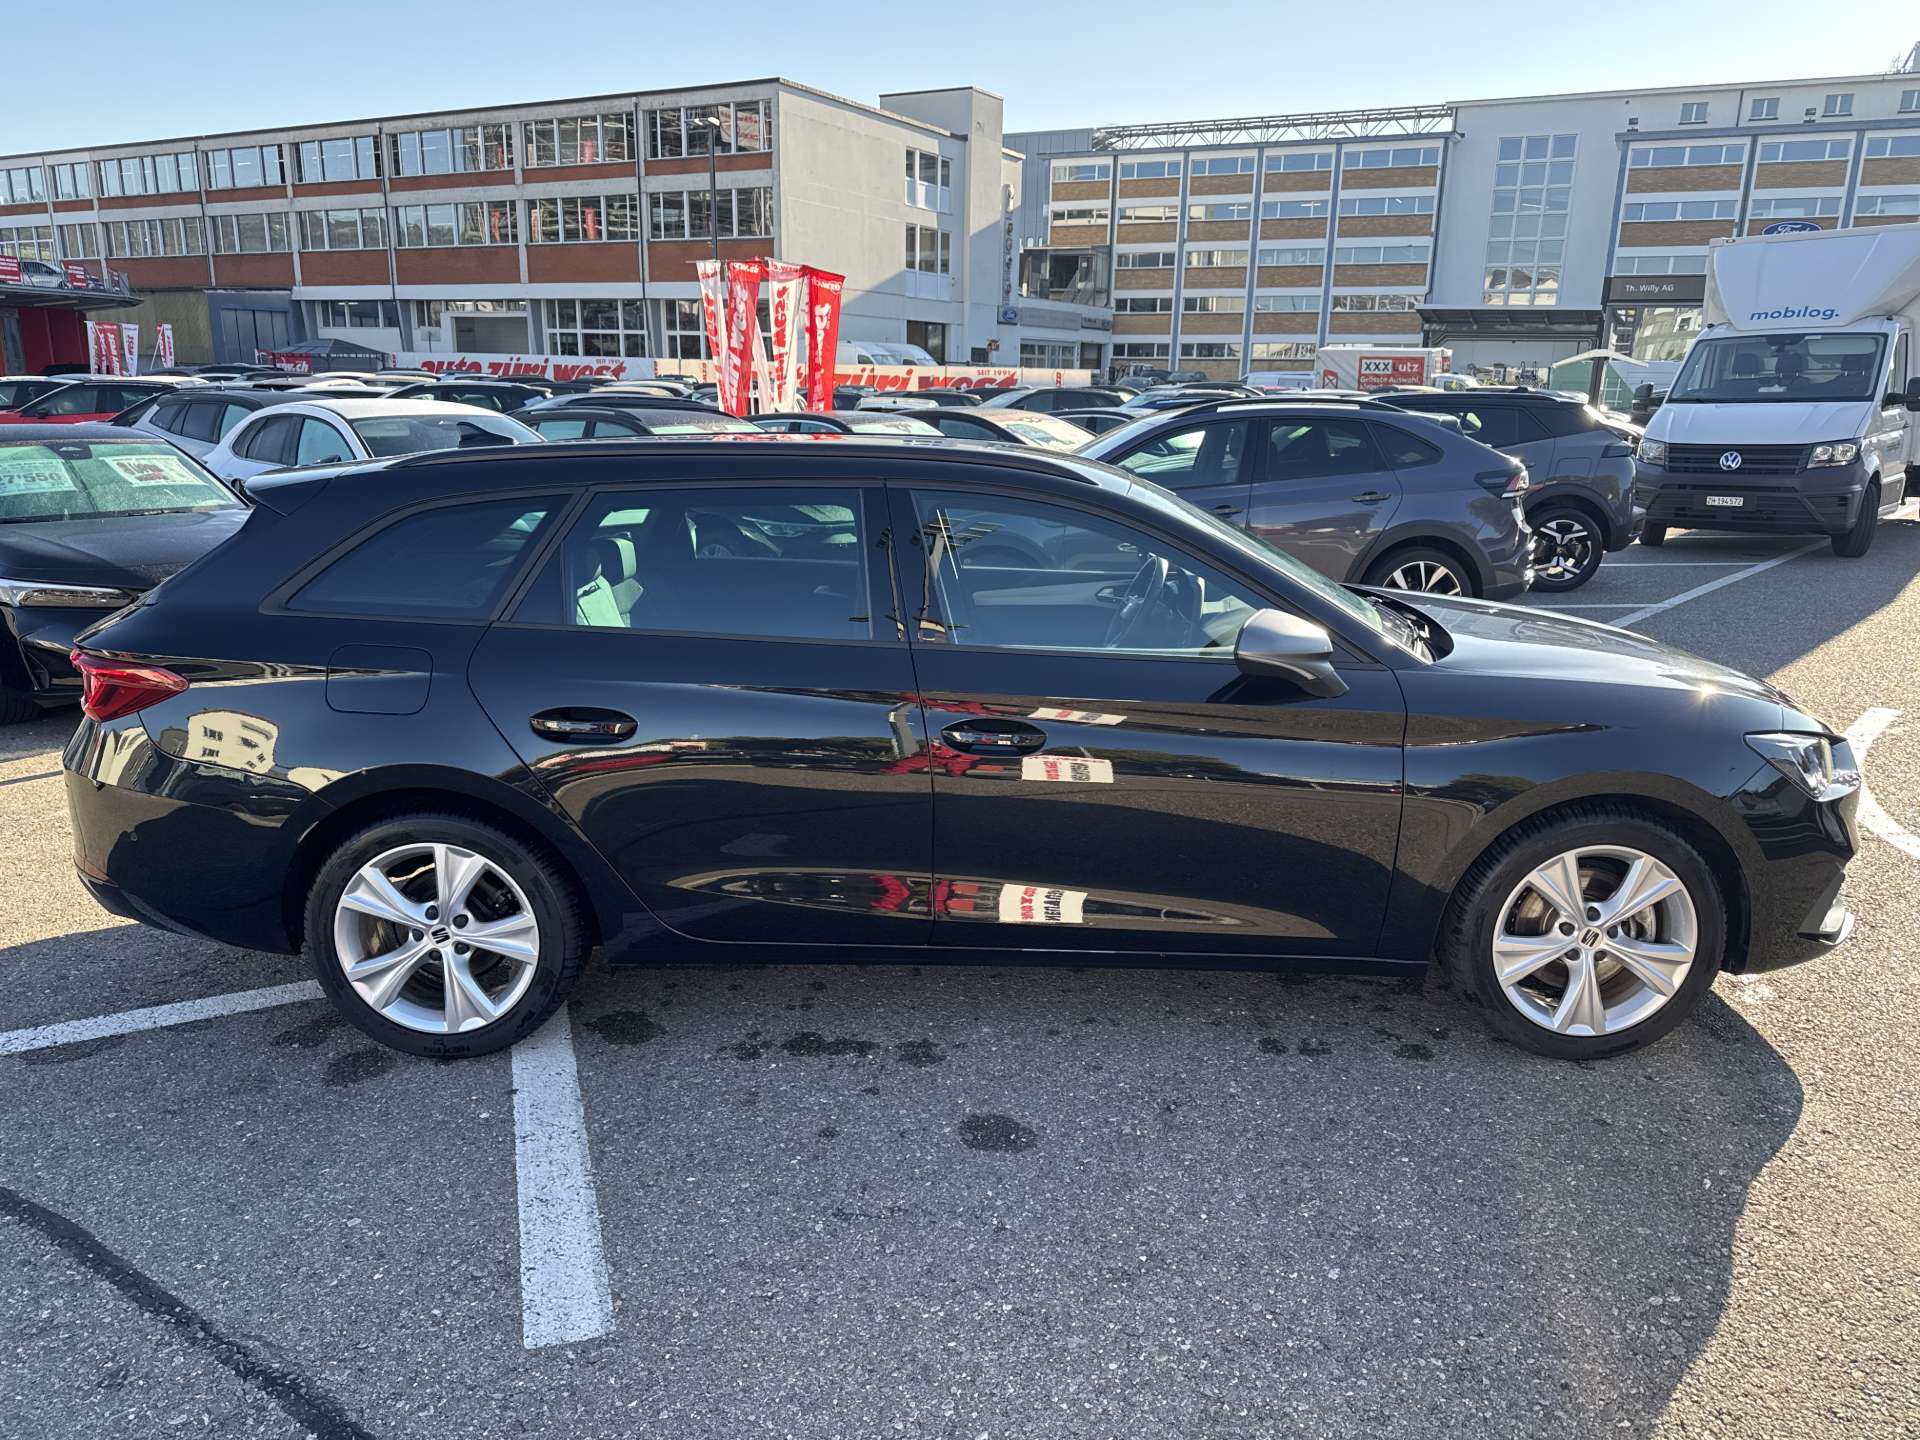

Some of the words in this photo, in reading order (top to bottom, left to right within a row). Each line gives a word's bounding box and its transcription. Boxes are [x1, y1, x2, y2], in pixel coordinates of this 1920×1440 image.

[1625, 284, 1638, 292] Th.
[1640, 284, 1660, 293] Willy
[1662, 284, 1675, 292] AG
[1750, 306, 1840, 321] mobilog.
[488, 357, 550, 378] züri
[553, 360, 627, 381] west
